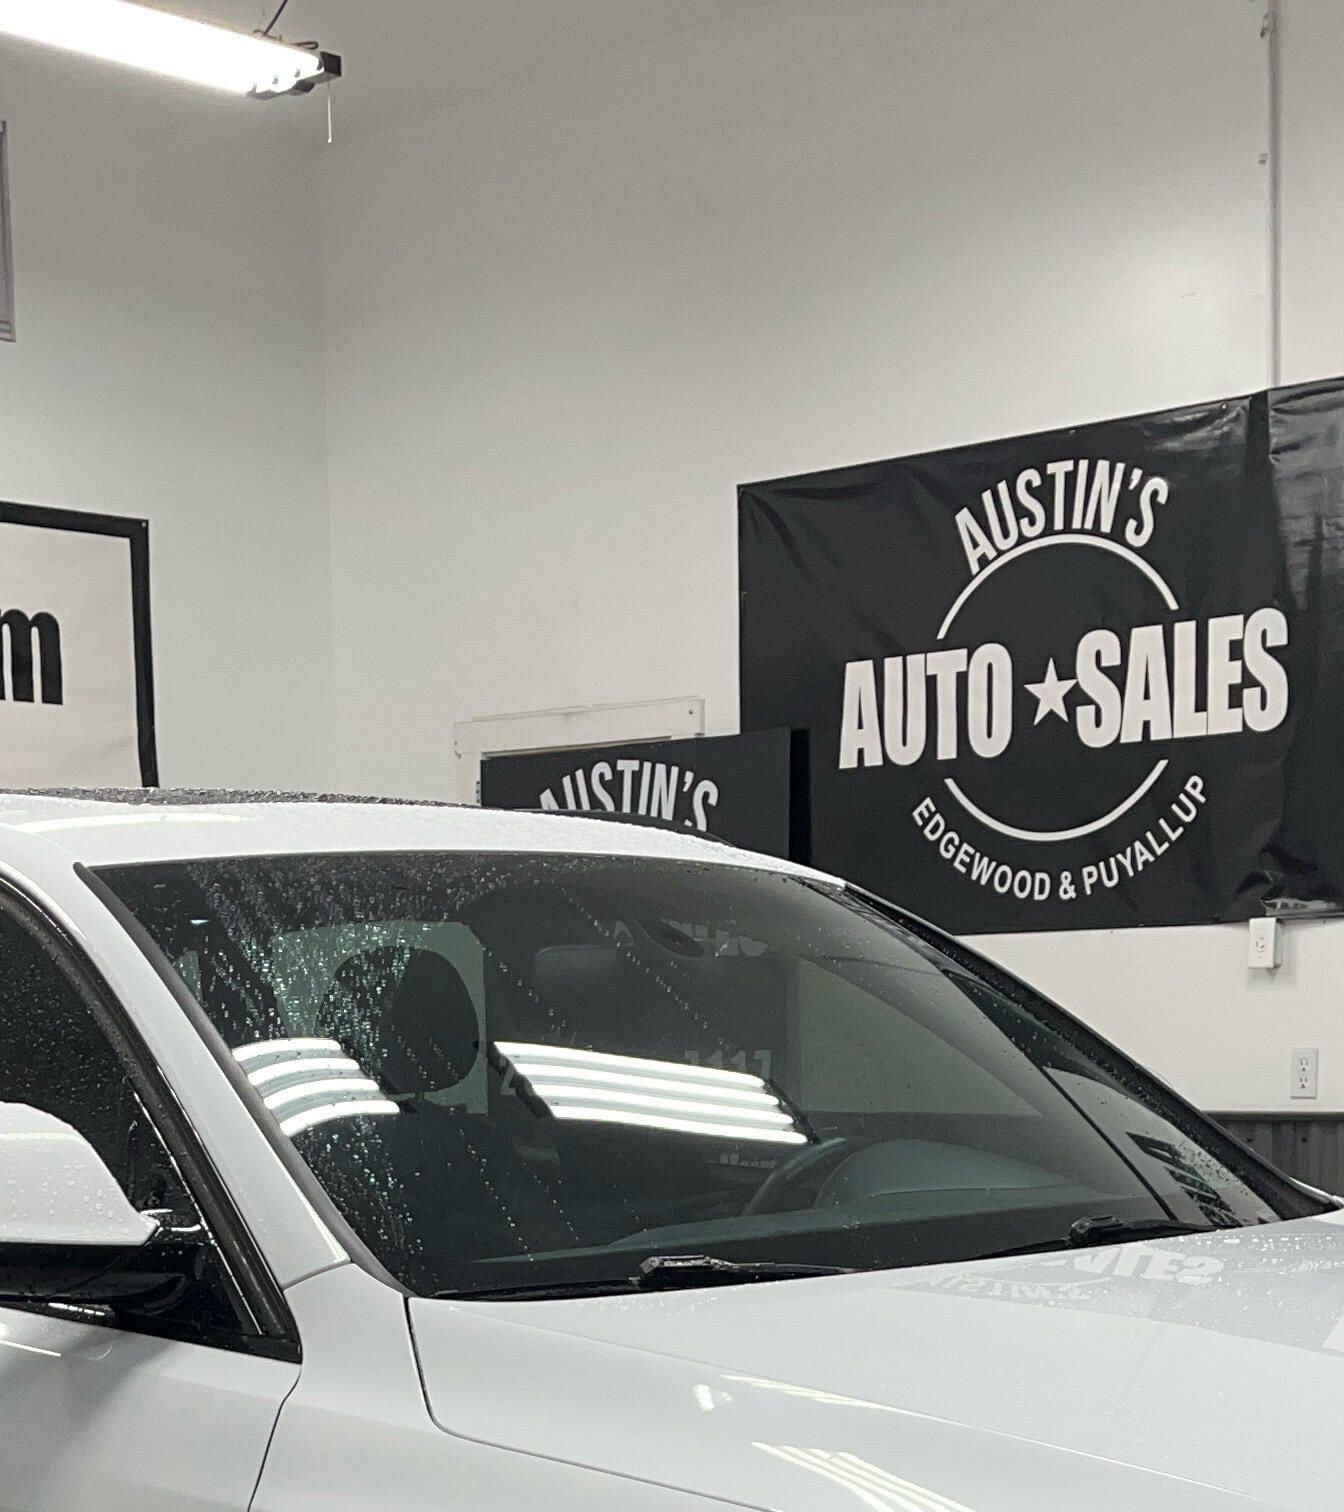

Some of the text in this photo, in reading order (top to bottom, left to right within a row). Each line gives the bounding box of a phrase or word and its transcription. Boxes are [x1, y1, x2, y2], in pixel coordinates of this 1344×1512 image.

[954, 459, 1169, 576] AUSTIN'S
[838, 606, 1289, 769] AUTO SALES
[912, 775, 1207, 901] EDGEWOOD & PUYALLUP
